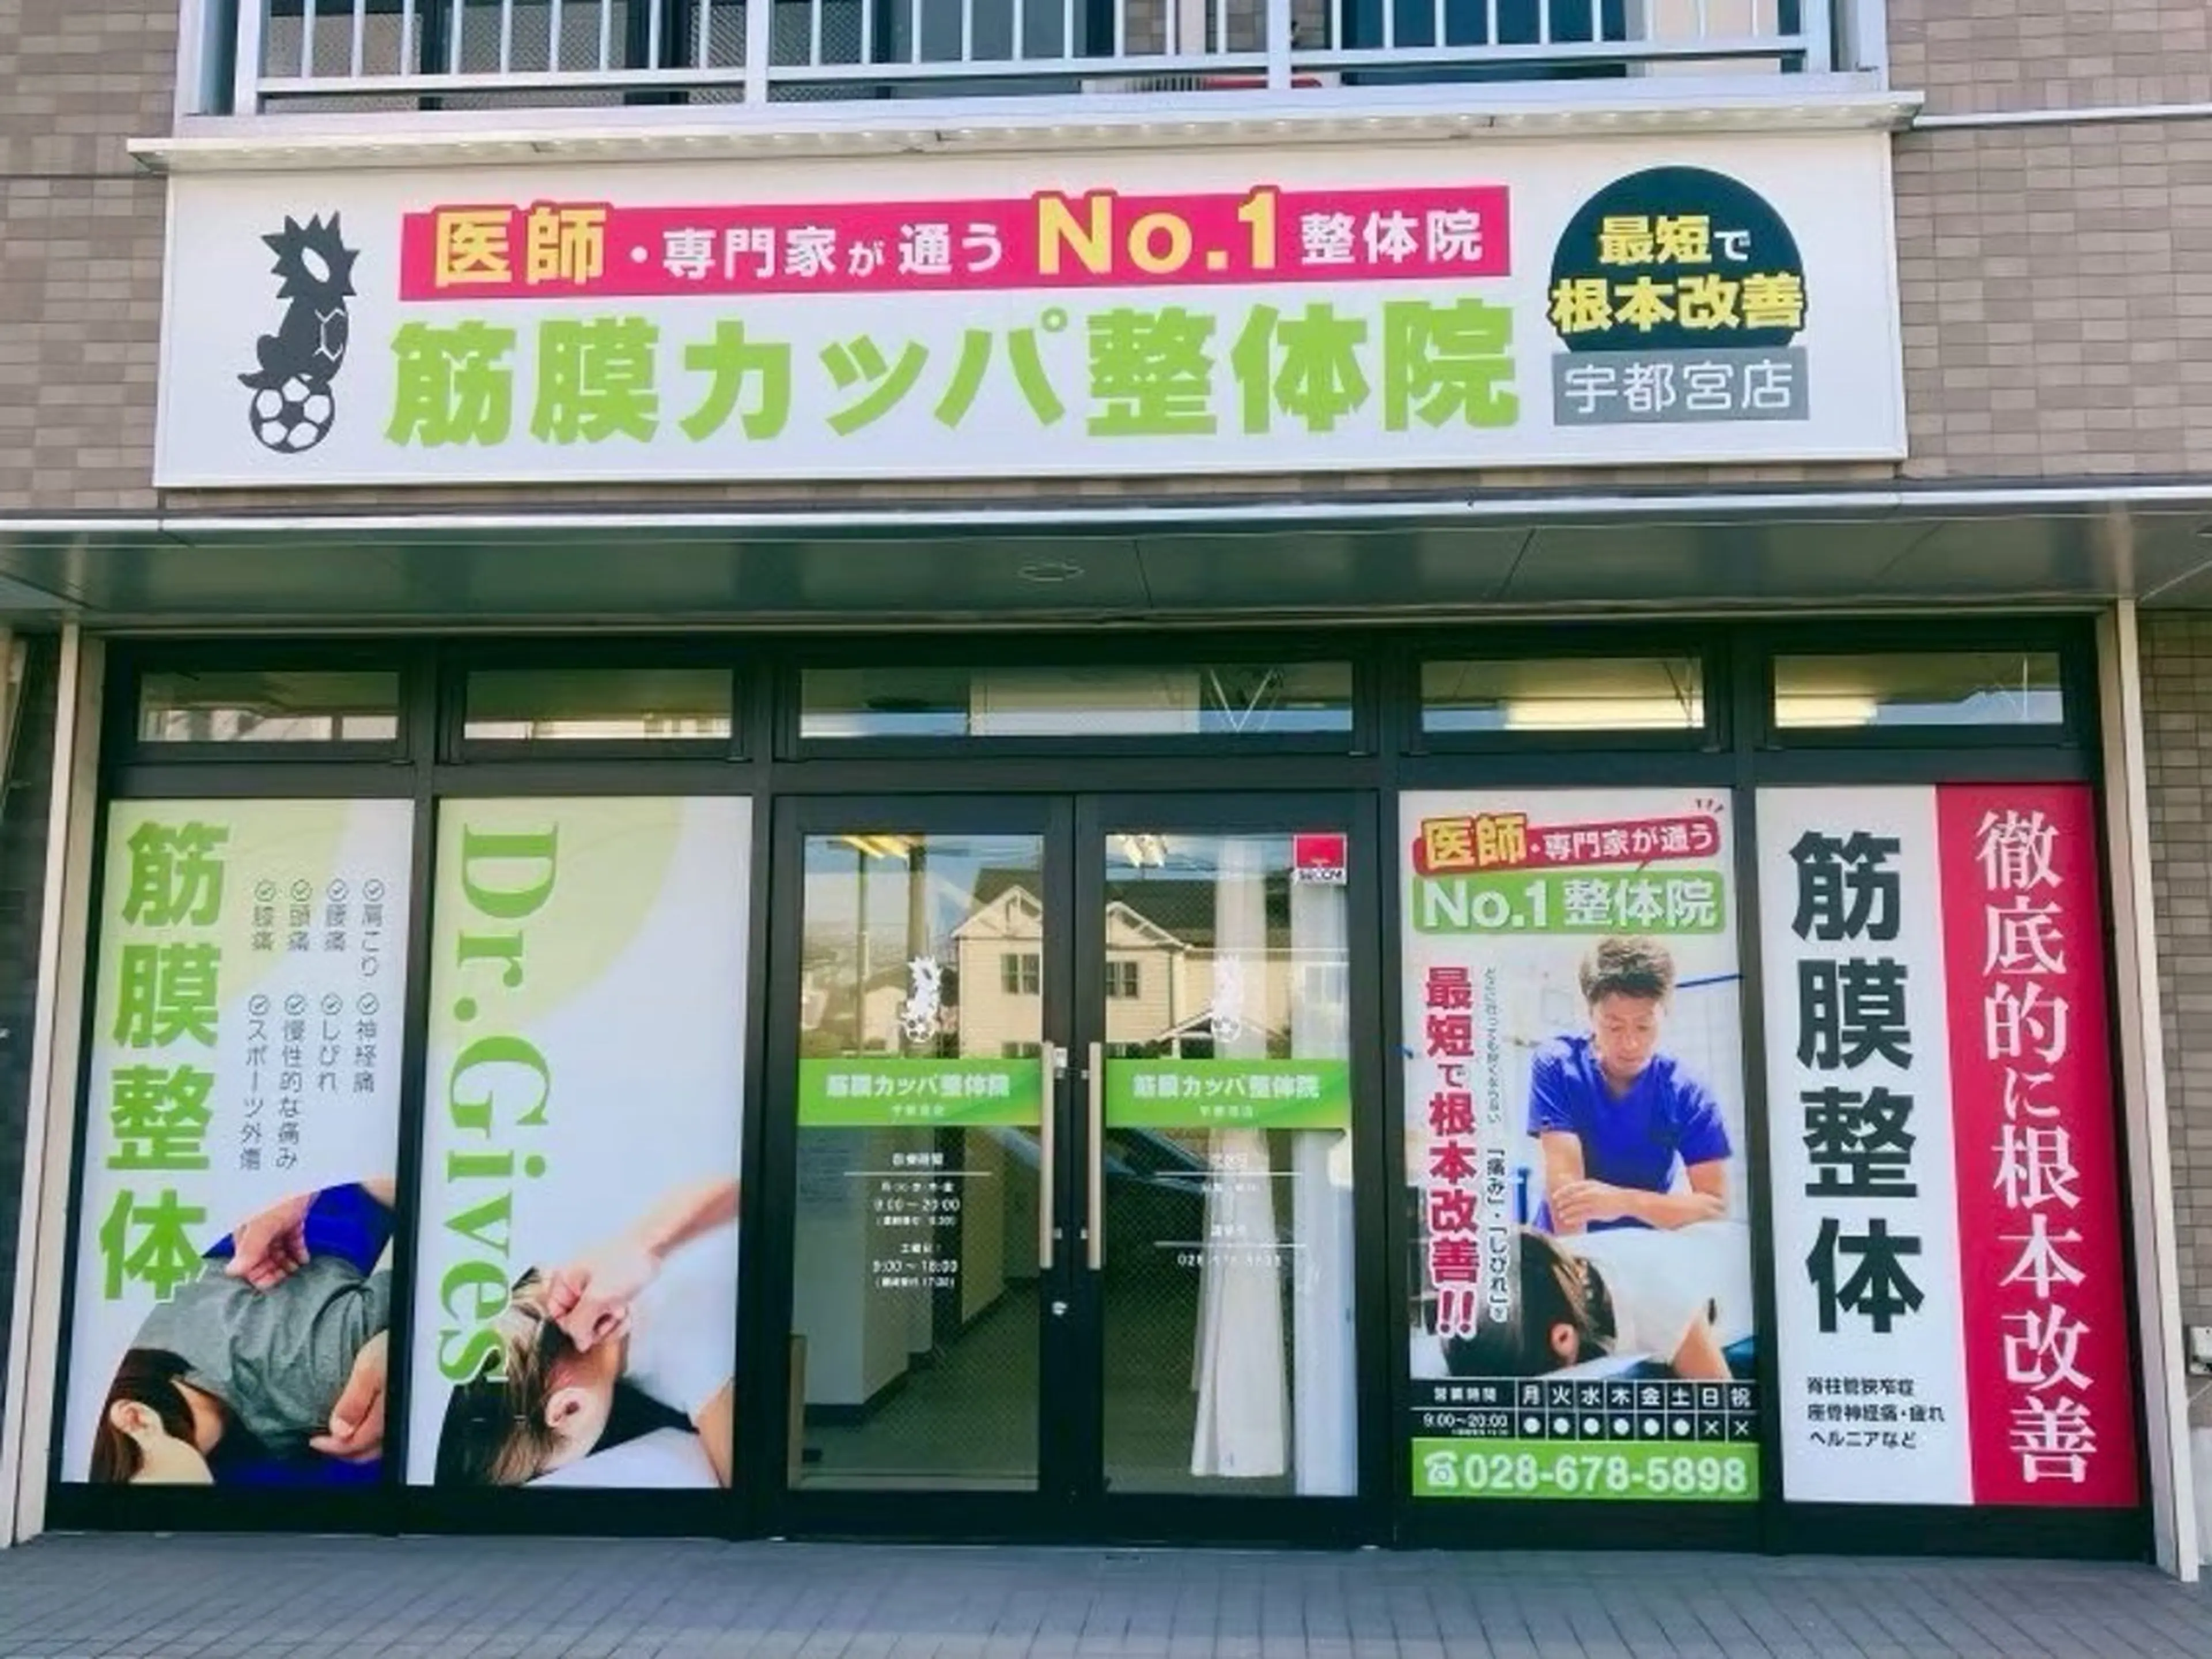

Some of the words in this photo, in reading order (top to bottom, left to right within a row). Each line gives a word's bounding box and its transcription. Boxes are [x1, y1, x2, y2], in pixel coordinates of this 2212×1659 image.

[1599, 215, 1750, 264] 最短で
[1552, 272, 1804, 333] 根本改善
[384, 298, 1520, 446] 筋膜カッパ整体院
[1565, 359, 1792, 413] 宇都宮店
[1423, 814, 1714, 868] 医師・専門家が通う
[1423, 878, 1715, 927] No.1整体院
[100, 821, 229, 1301] 筋膜整体
[318, 1018, 341, 1092] しびれ
[1789, 830, 1925, 1335] 筋膜整体
[435, 823, 559, 1384] Dr.Gives
[1975, 808, 2097, 1484] 徹底的に根本改善
[1522, 1385, 1540, 1405] 月
[1551, 1385, 1571, 1405] 火
[1581, 1385, 1601, 1406] 水
[1611, 1387, 1630, 1406] 木
[1641, 1387, 1660, 1406] 金
[1671, 1387, 1691, 1406] 土
[1702, 1388, 1718, 1407] 日
[1730, 1387, 1751, 1408] 祝
[1810, 1431, 1916, 1449] ヘルニアなど
[1464, 1454, 1747, 1493] 028-678-5898
